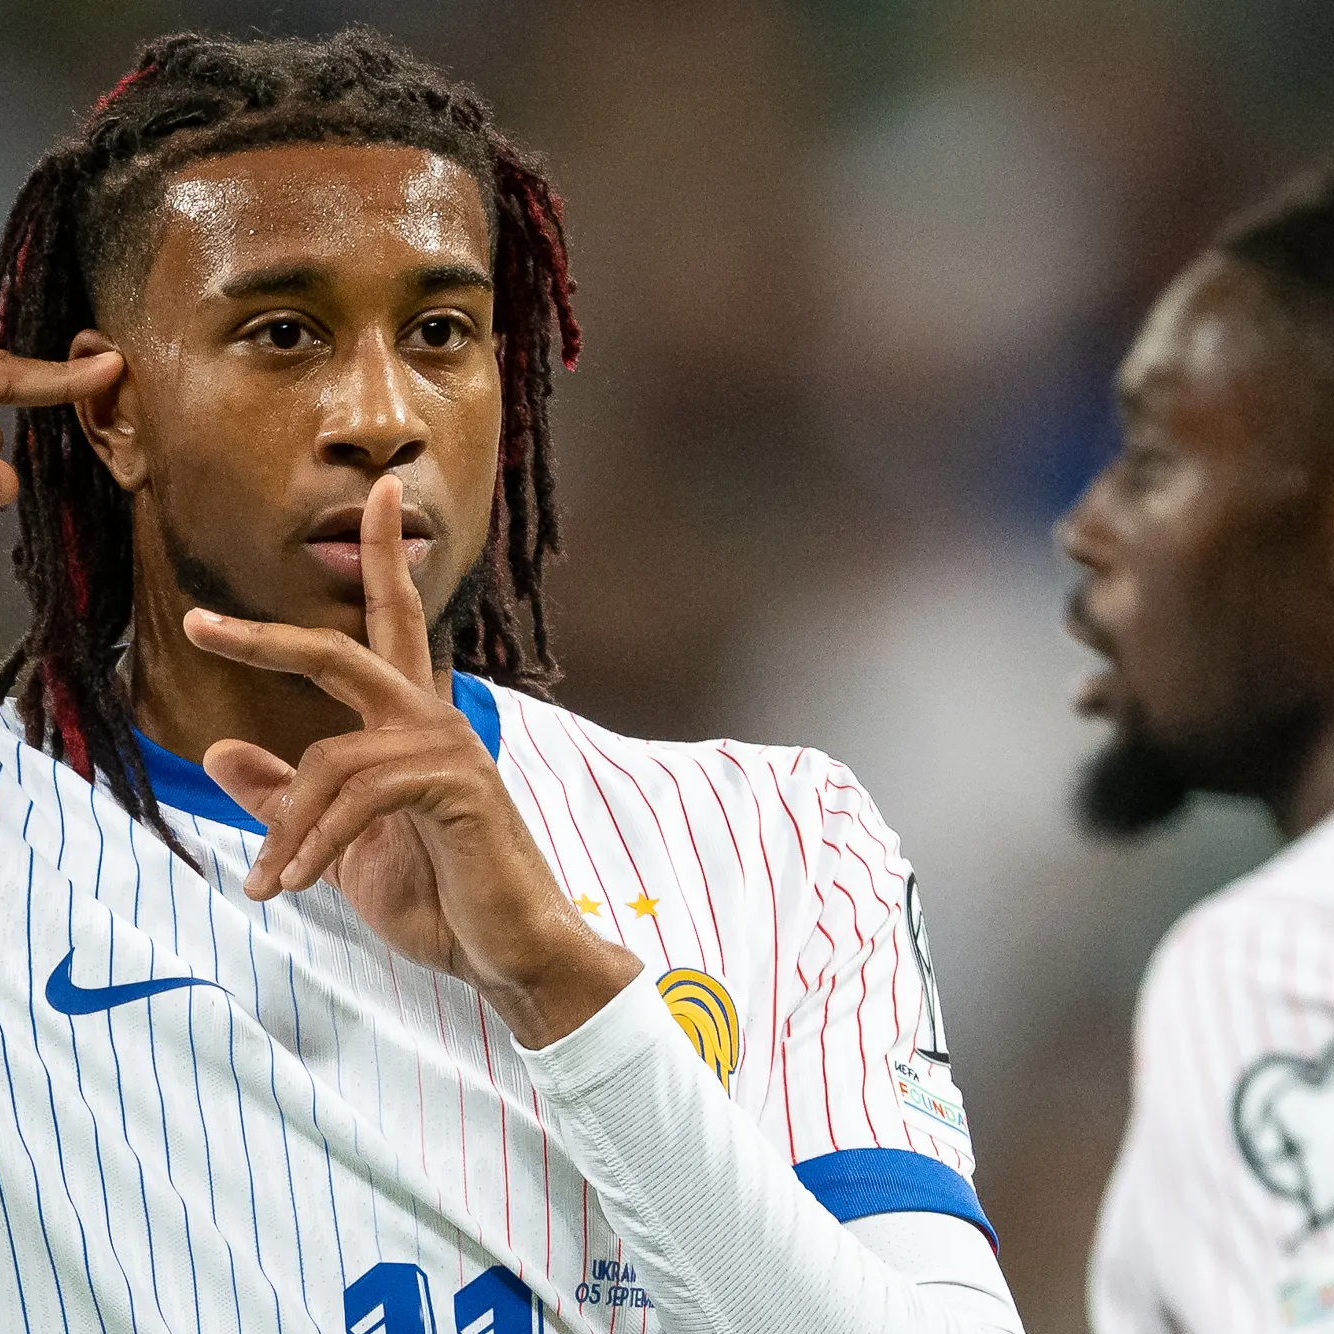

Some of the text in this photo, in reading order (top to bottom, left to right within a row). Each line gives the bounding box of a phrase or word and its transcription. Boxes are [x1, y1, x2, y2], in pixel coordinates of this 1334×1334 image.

[894, 1060, 920, 1083] UEFA
[898, 1080, 968, 1132] FOUNDA
[575, 1282, 601, 1305] 05
